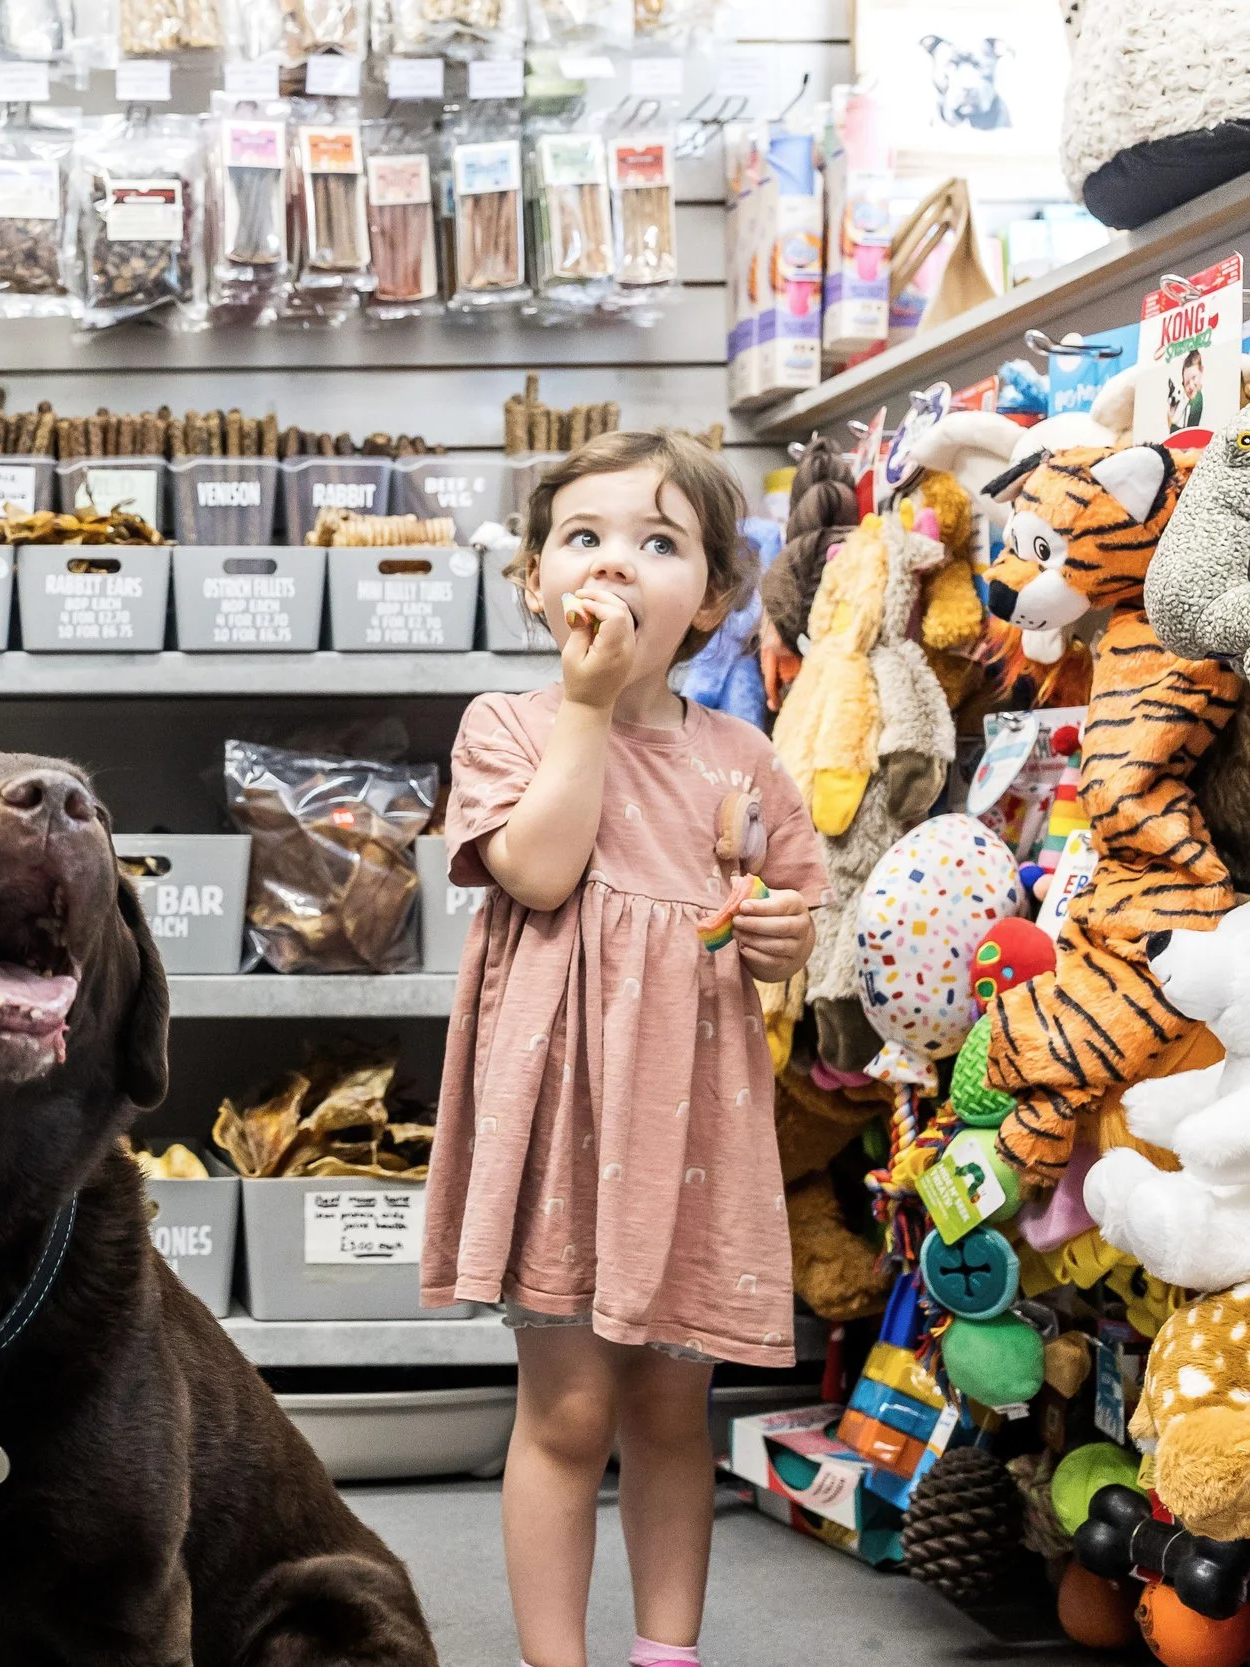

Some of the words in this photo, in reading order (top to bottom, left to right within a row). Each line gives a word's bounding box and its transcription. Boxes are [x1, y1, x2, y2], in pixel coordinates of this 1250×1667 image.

[1161, 302, 1206, 347] KONG
[197, 481, 261, 507] VENISON
[313, 483, 377, 508] RABBIT
[45, 574, 102, 595] RABBIT
[106, 576, 142, 597] EARS
[203, 577, 252, 598] OSTRICH
[253, 577, 296, 598] FILLETS
[157, 885, 224, 916] BAR
[146, 915, 189, 938] ACH
[154, 1225, 212, 1256] ONES
